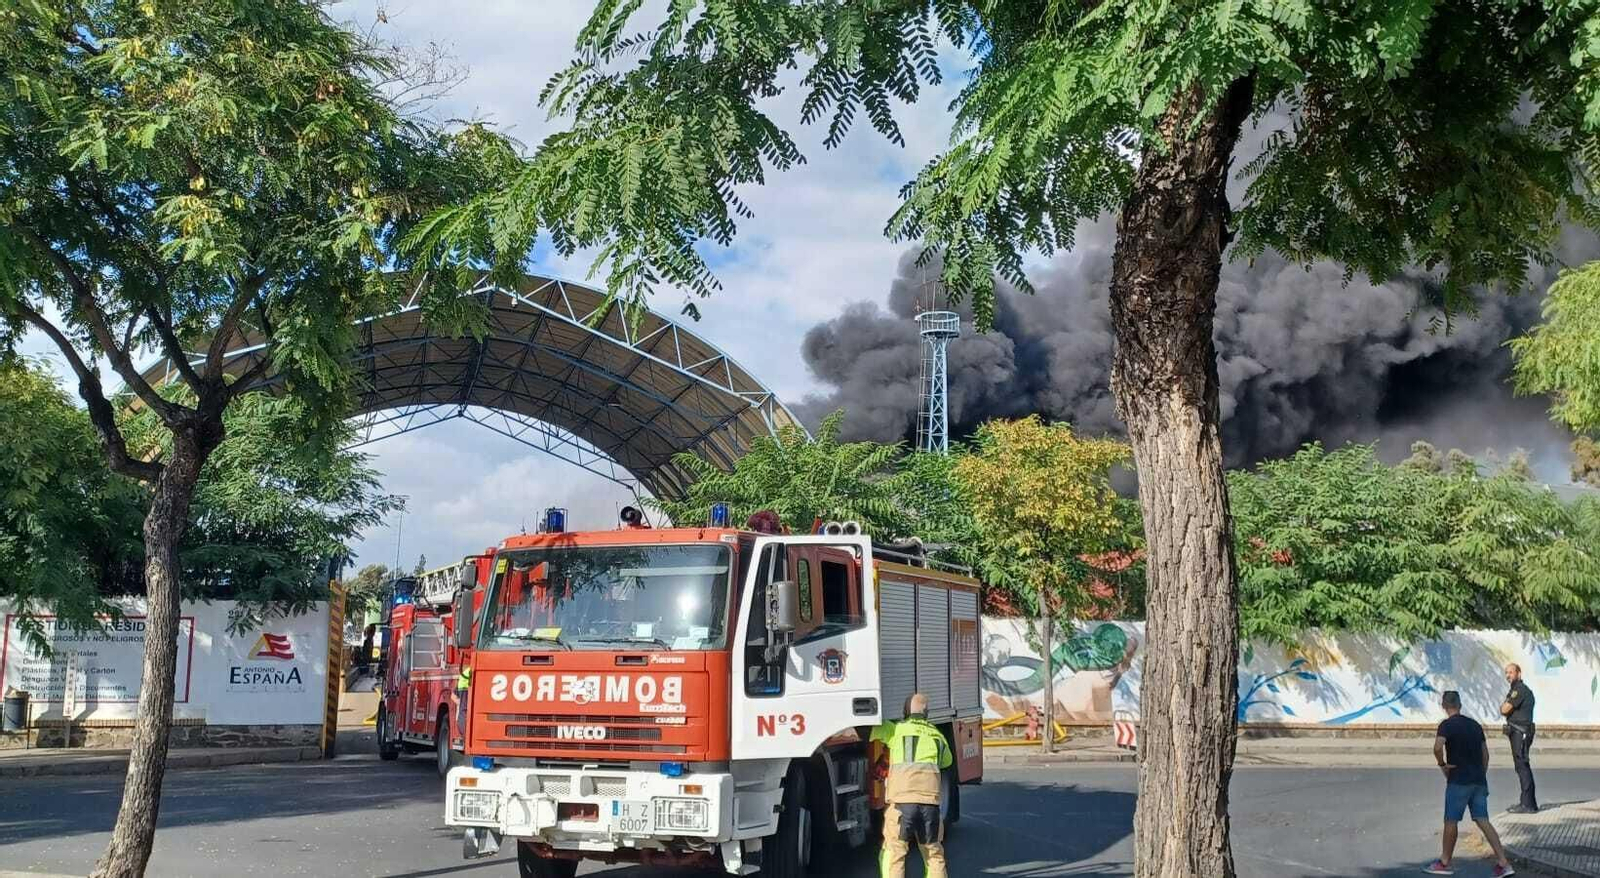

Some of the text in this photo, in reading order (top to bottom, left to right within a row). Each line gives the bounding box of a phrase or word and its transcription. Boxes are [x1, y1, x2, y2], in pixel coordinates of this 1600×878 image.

[229, 666, 302, 685] ESPAÑA
[790, 713, 806, 736] 3
[557, 725, 606, 741] IVECO
[622, 803, 648, 818] H Z
[620, 818, 648, 832] 6007
